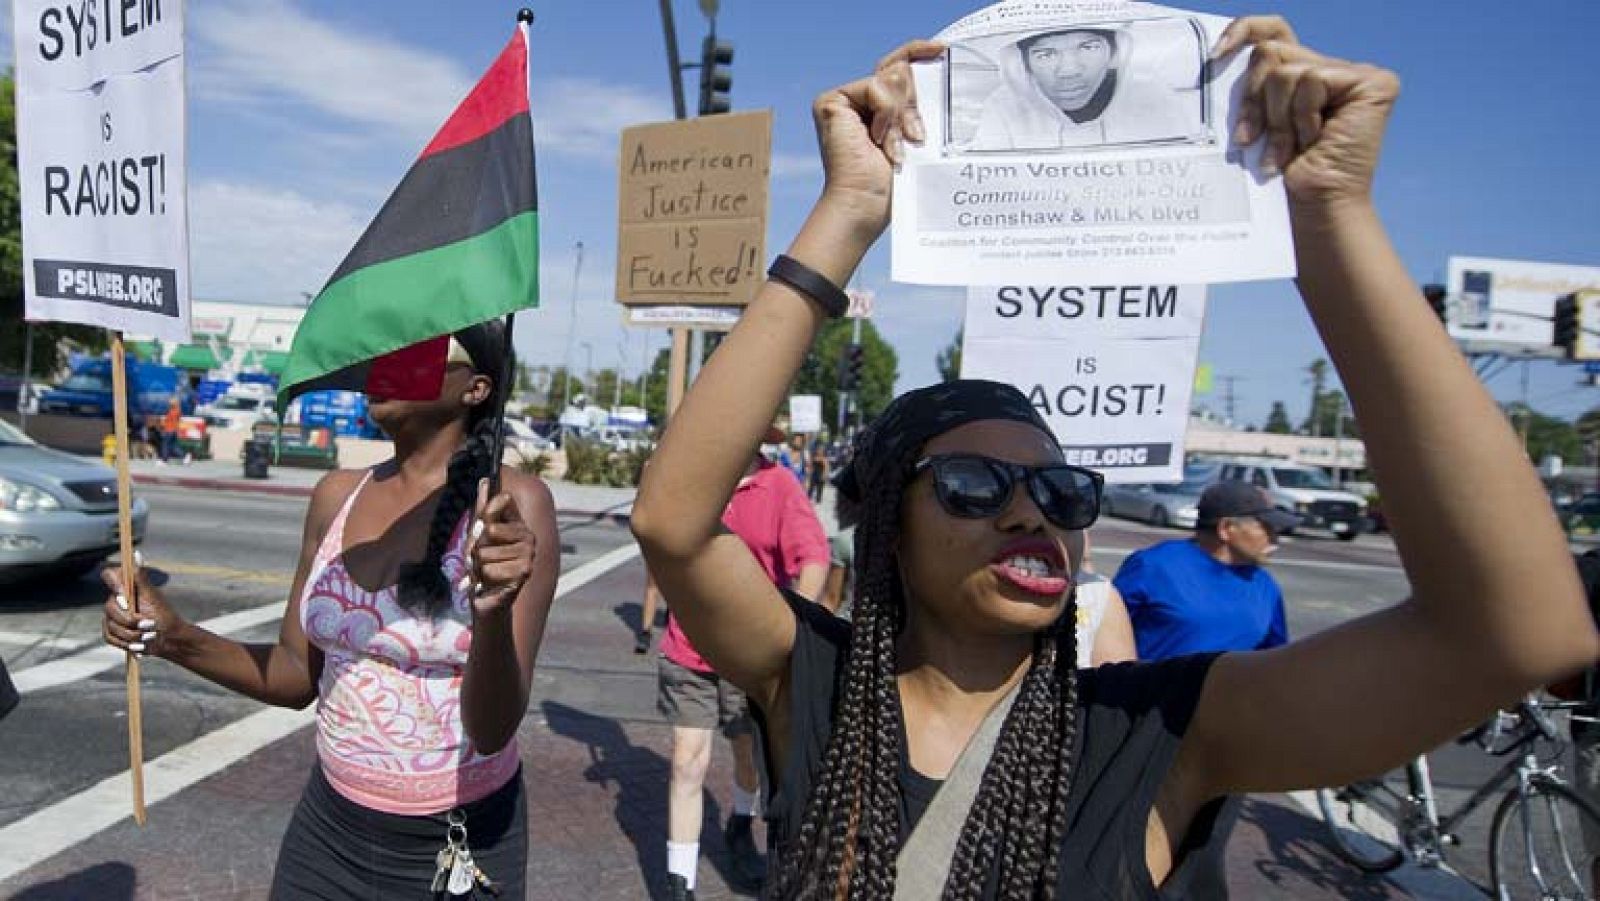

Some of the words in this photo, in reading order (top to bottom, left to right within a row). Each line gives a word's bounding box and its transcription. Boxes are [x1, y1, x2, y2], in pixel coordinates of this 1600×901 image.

[39, 0, 161, 61] SYSTEM
[100, 111, 112, 142] IS
[630, 144, 752, 174] American
[960, 162, 1017, 184] 4pm
[1027, 161, 1125, 178] Verdict
[1136, 158, 1190, 178] Day
[45, 153, 165, 217] RACIST!
[643, 180, 748, 218] Justice
[953, 185, 1070, 205] Community
[958, 209, 1063, 226] Crenshaw
[1071, 207, 1084, 223] &
[1094, 206, 1144, 222] MLK
[629, 242, 757, 290] Fucked!
[996, 285, 1178, 319] SYSTEM
[1076, 357, 1097, 375] IS
[1028, 384, 1166, 417] ACIST!
[1065, 446, 1149, 466] EB.ORG
